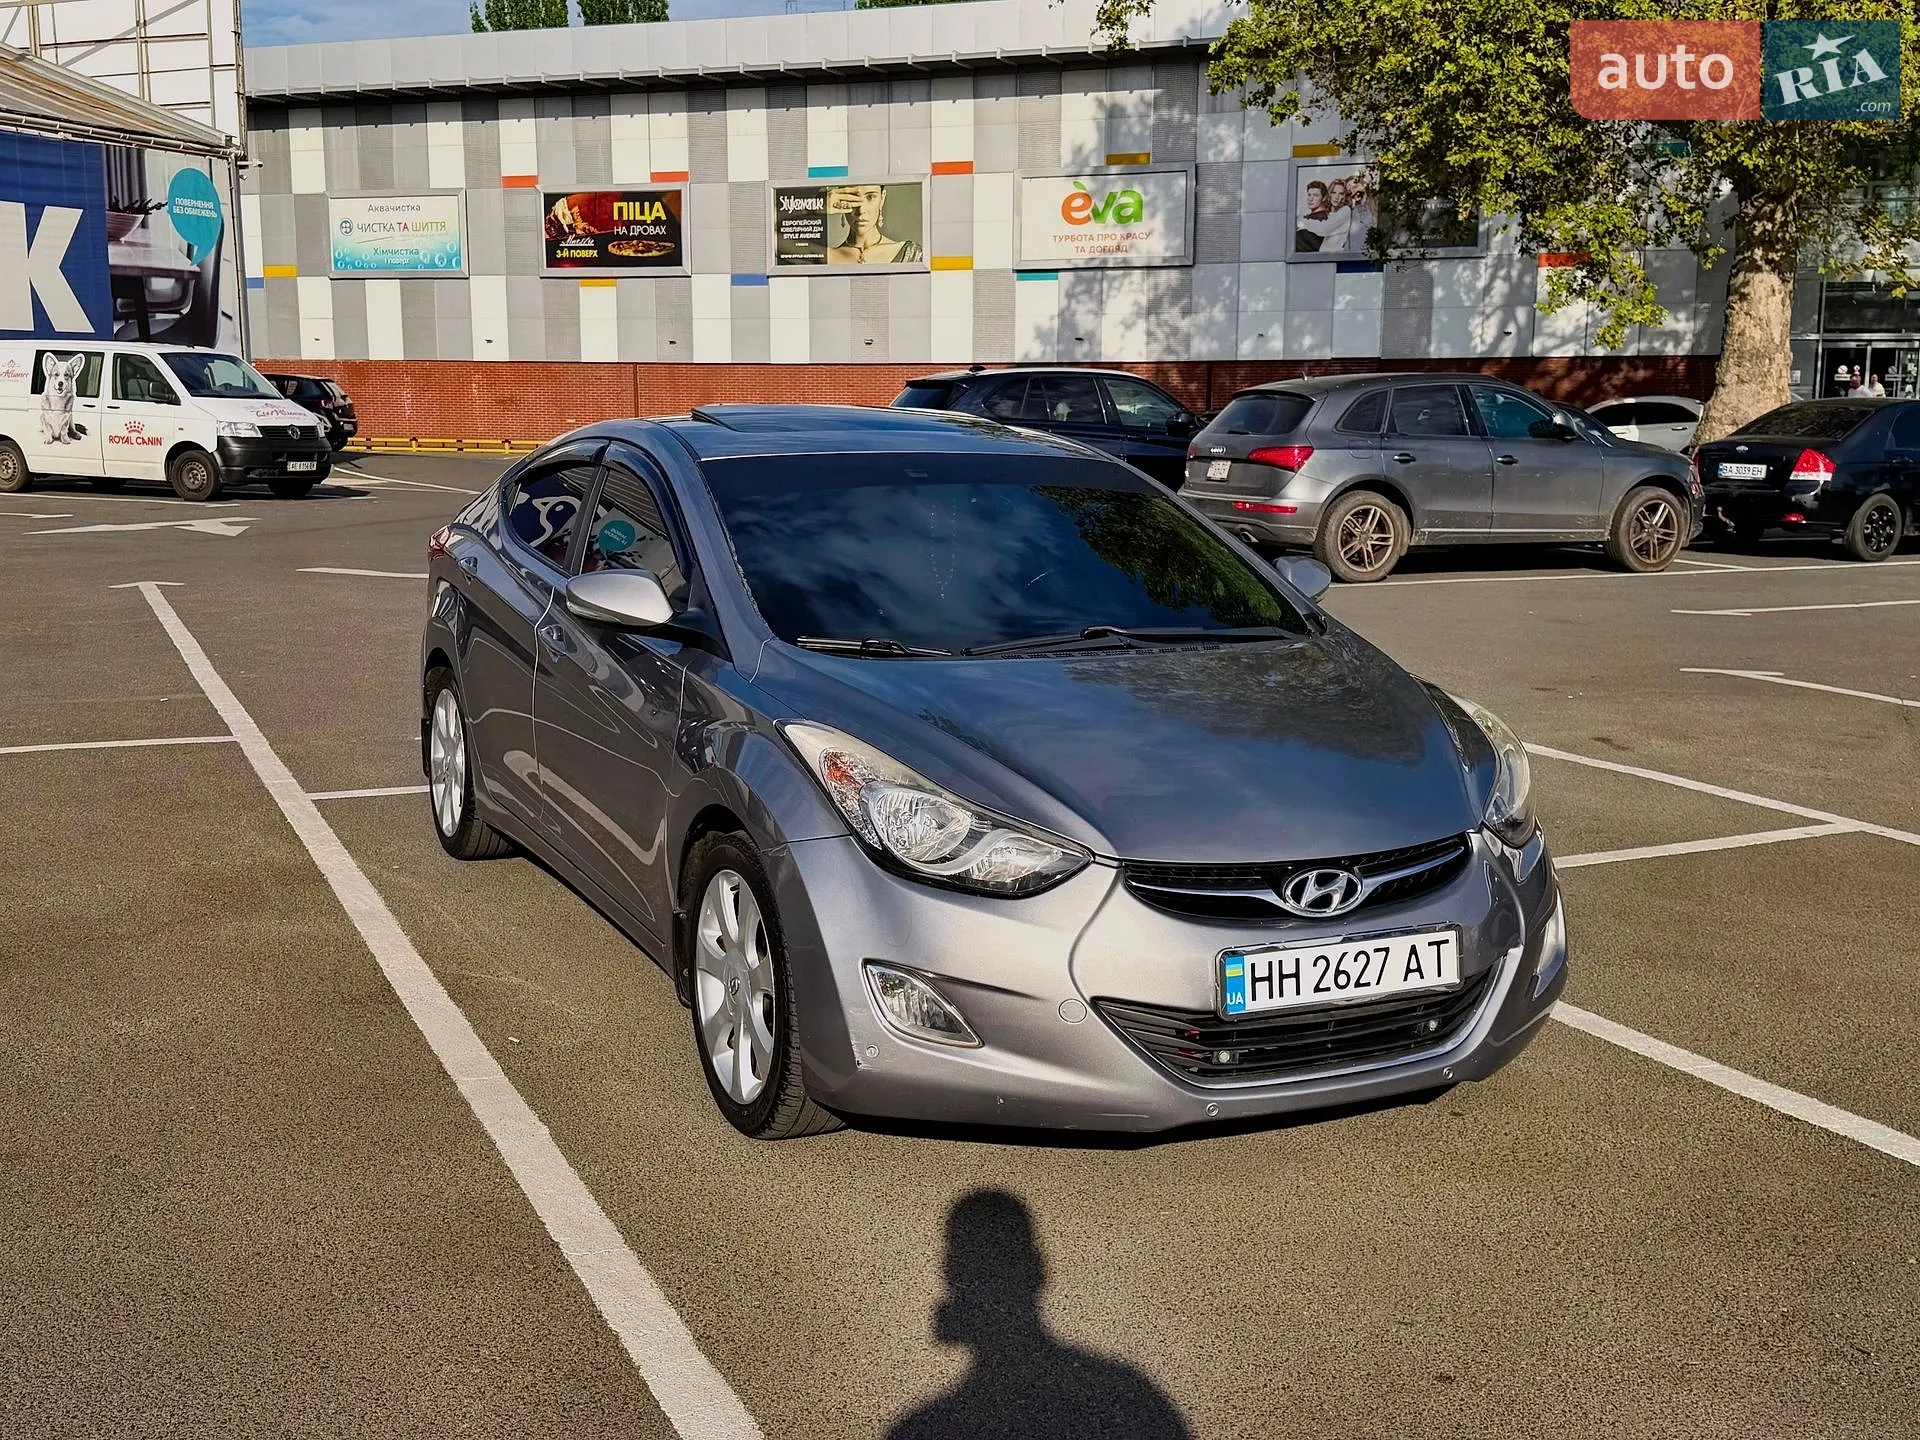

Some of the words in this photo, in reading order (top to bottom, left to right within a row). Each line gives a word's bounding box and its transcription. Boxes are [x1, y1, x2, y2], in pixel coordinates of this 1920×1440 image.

[175, 197, 214, 209] ПОВЕРНЕННЯ
[367, 203, 421, 212] Аквачистка
[172, 205, 184, 214] БЕЗ
[184, 207, 217, 218] ОБМЕЖЕНЬ
[613, 201, 667, 224] ПІЦА
[356, 222, 395, 233] ЧИСТКА
[396, 222, 409, 232] ТА
[411, 221, 447, 232] ШИТТЯ
[614, 226, 628, 235] НА
[629, 225, 667, 236] ДРОВАХ
[1053, 233, 1094, 242] ТУРБОТА
[1097, 233, 1117, 241] ПРО
[1119, 232, 1151, 241] КРАСУ
[373, 246, 420, 256] Хімчистка
[556, 248, 570, 258] 3-Й
[570, 249, 598, 258] ПОВЕРХ
[1075, 246, 1086, 254] ТА
[1089, 245, 1128, 254] ДОГЛЯД
[108, 435, 134, 445] ROYAL
[135, 436, 162, 446] CANIN
[1751, 466, 1763, 476] EH
[1250, 957, 1300, 1002] HH
[1312, 946, 1390, 994] 2627
[1402, 939, 1450, 982] AT
[1227, 991, 1244, 1005] UA
